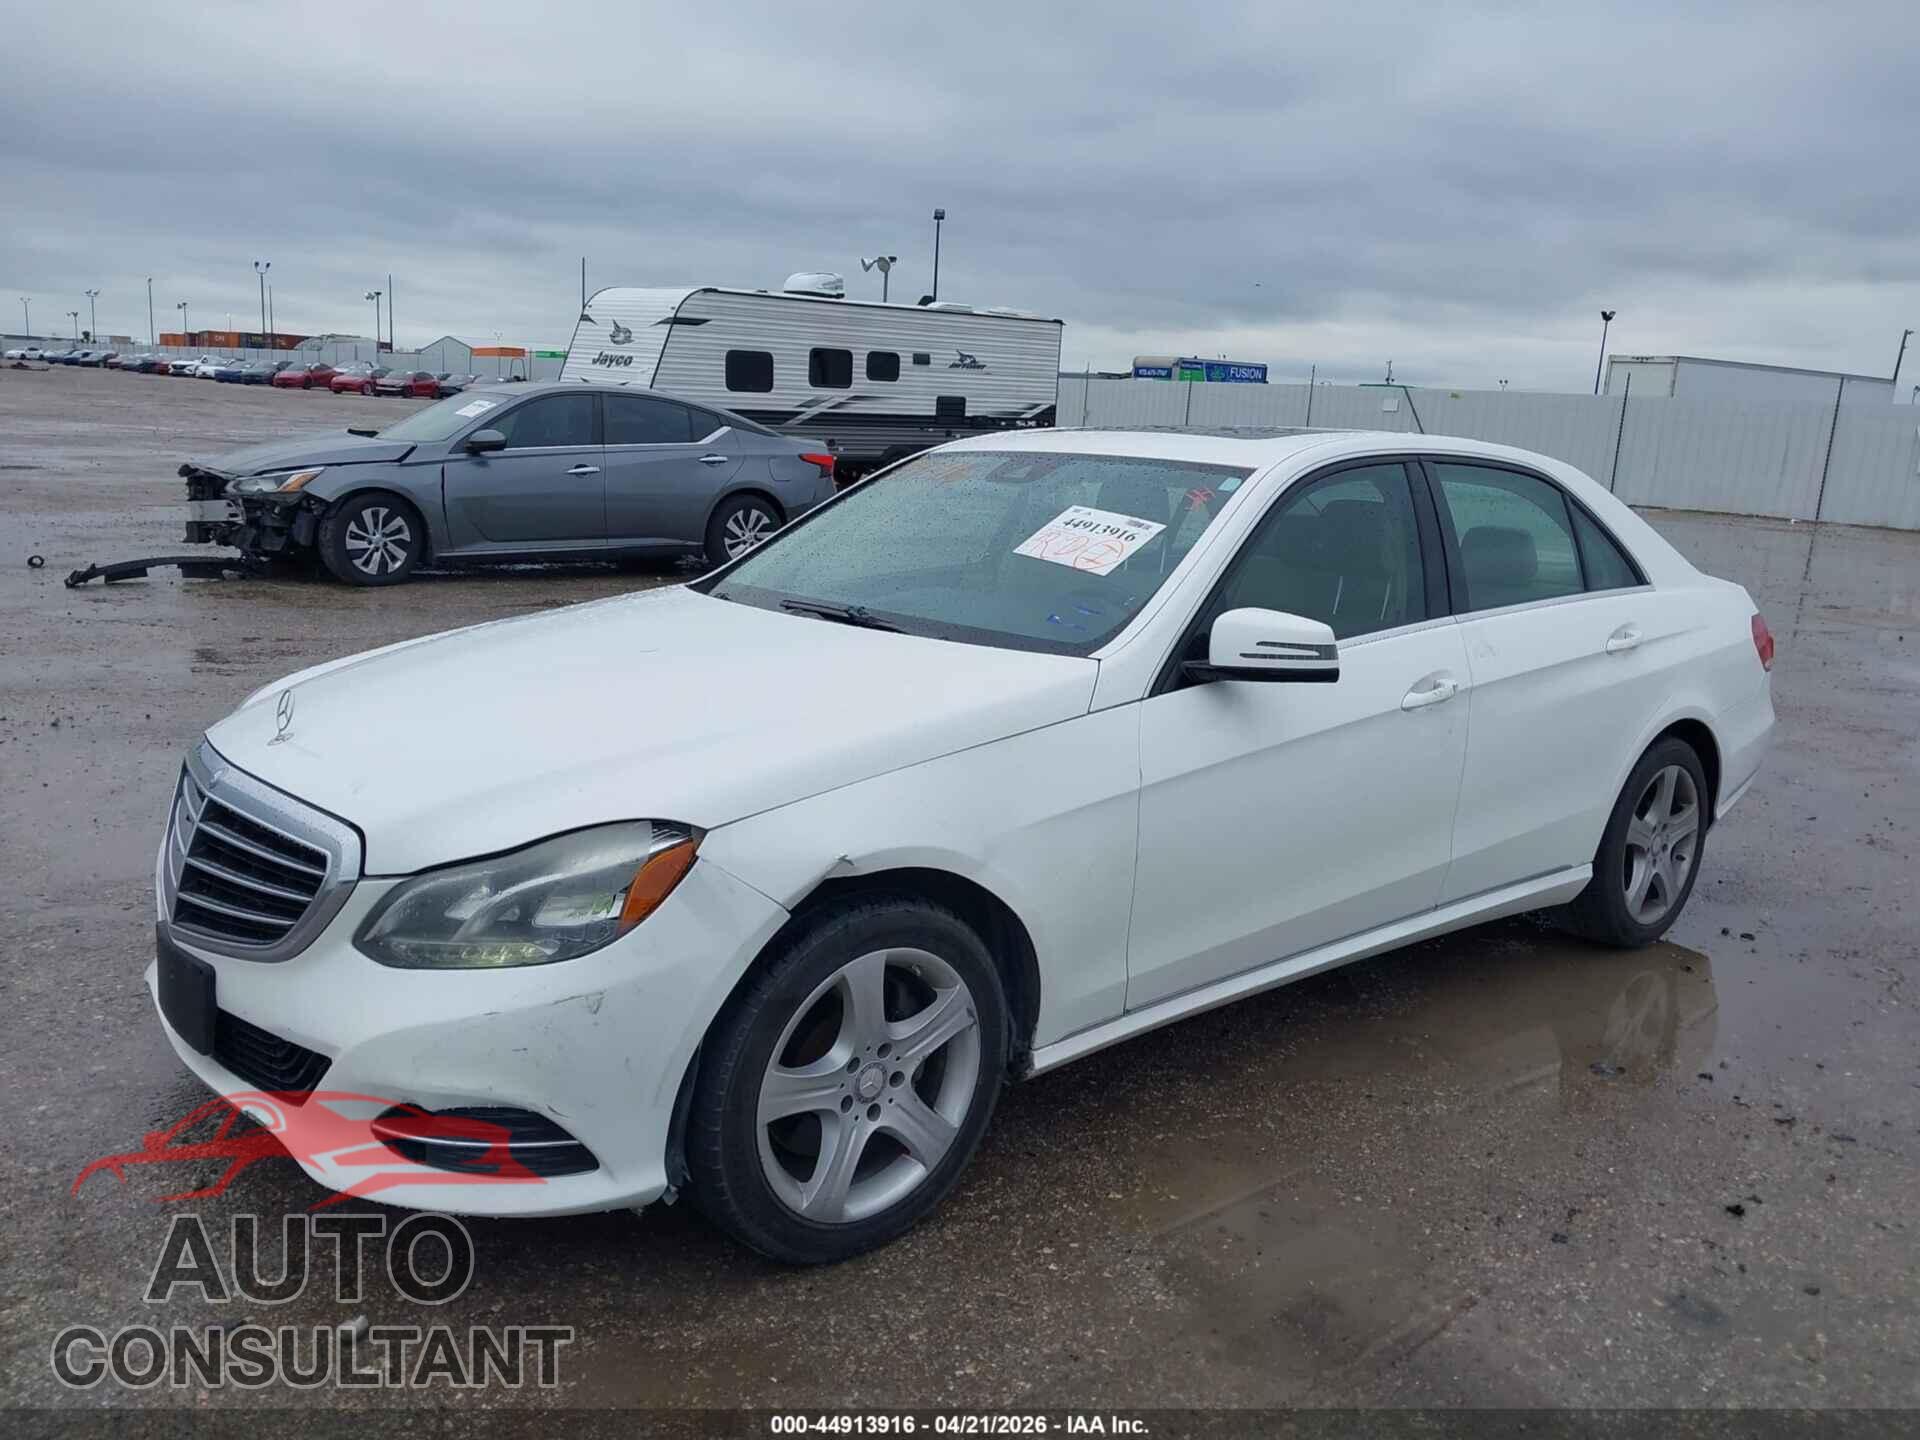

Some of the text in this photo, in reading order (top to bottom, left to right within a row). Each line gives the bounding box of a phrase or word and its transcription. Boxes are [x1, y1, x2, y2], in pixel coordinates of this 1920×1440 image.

[591, 350, 633, 368] Jayco
[1231, 367, 1263, 379] FUSION
[1062, 517, 1138, 543] 44913916
